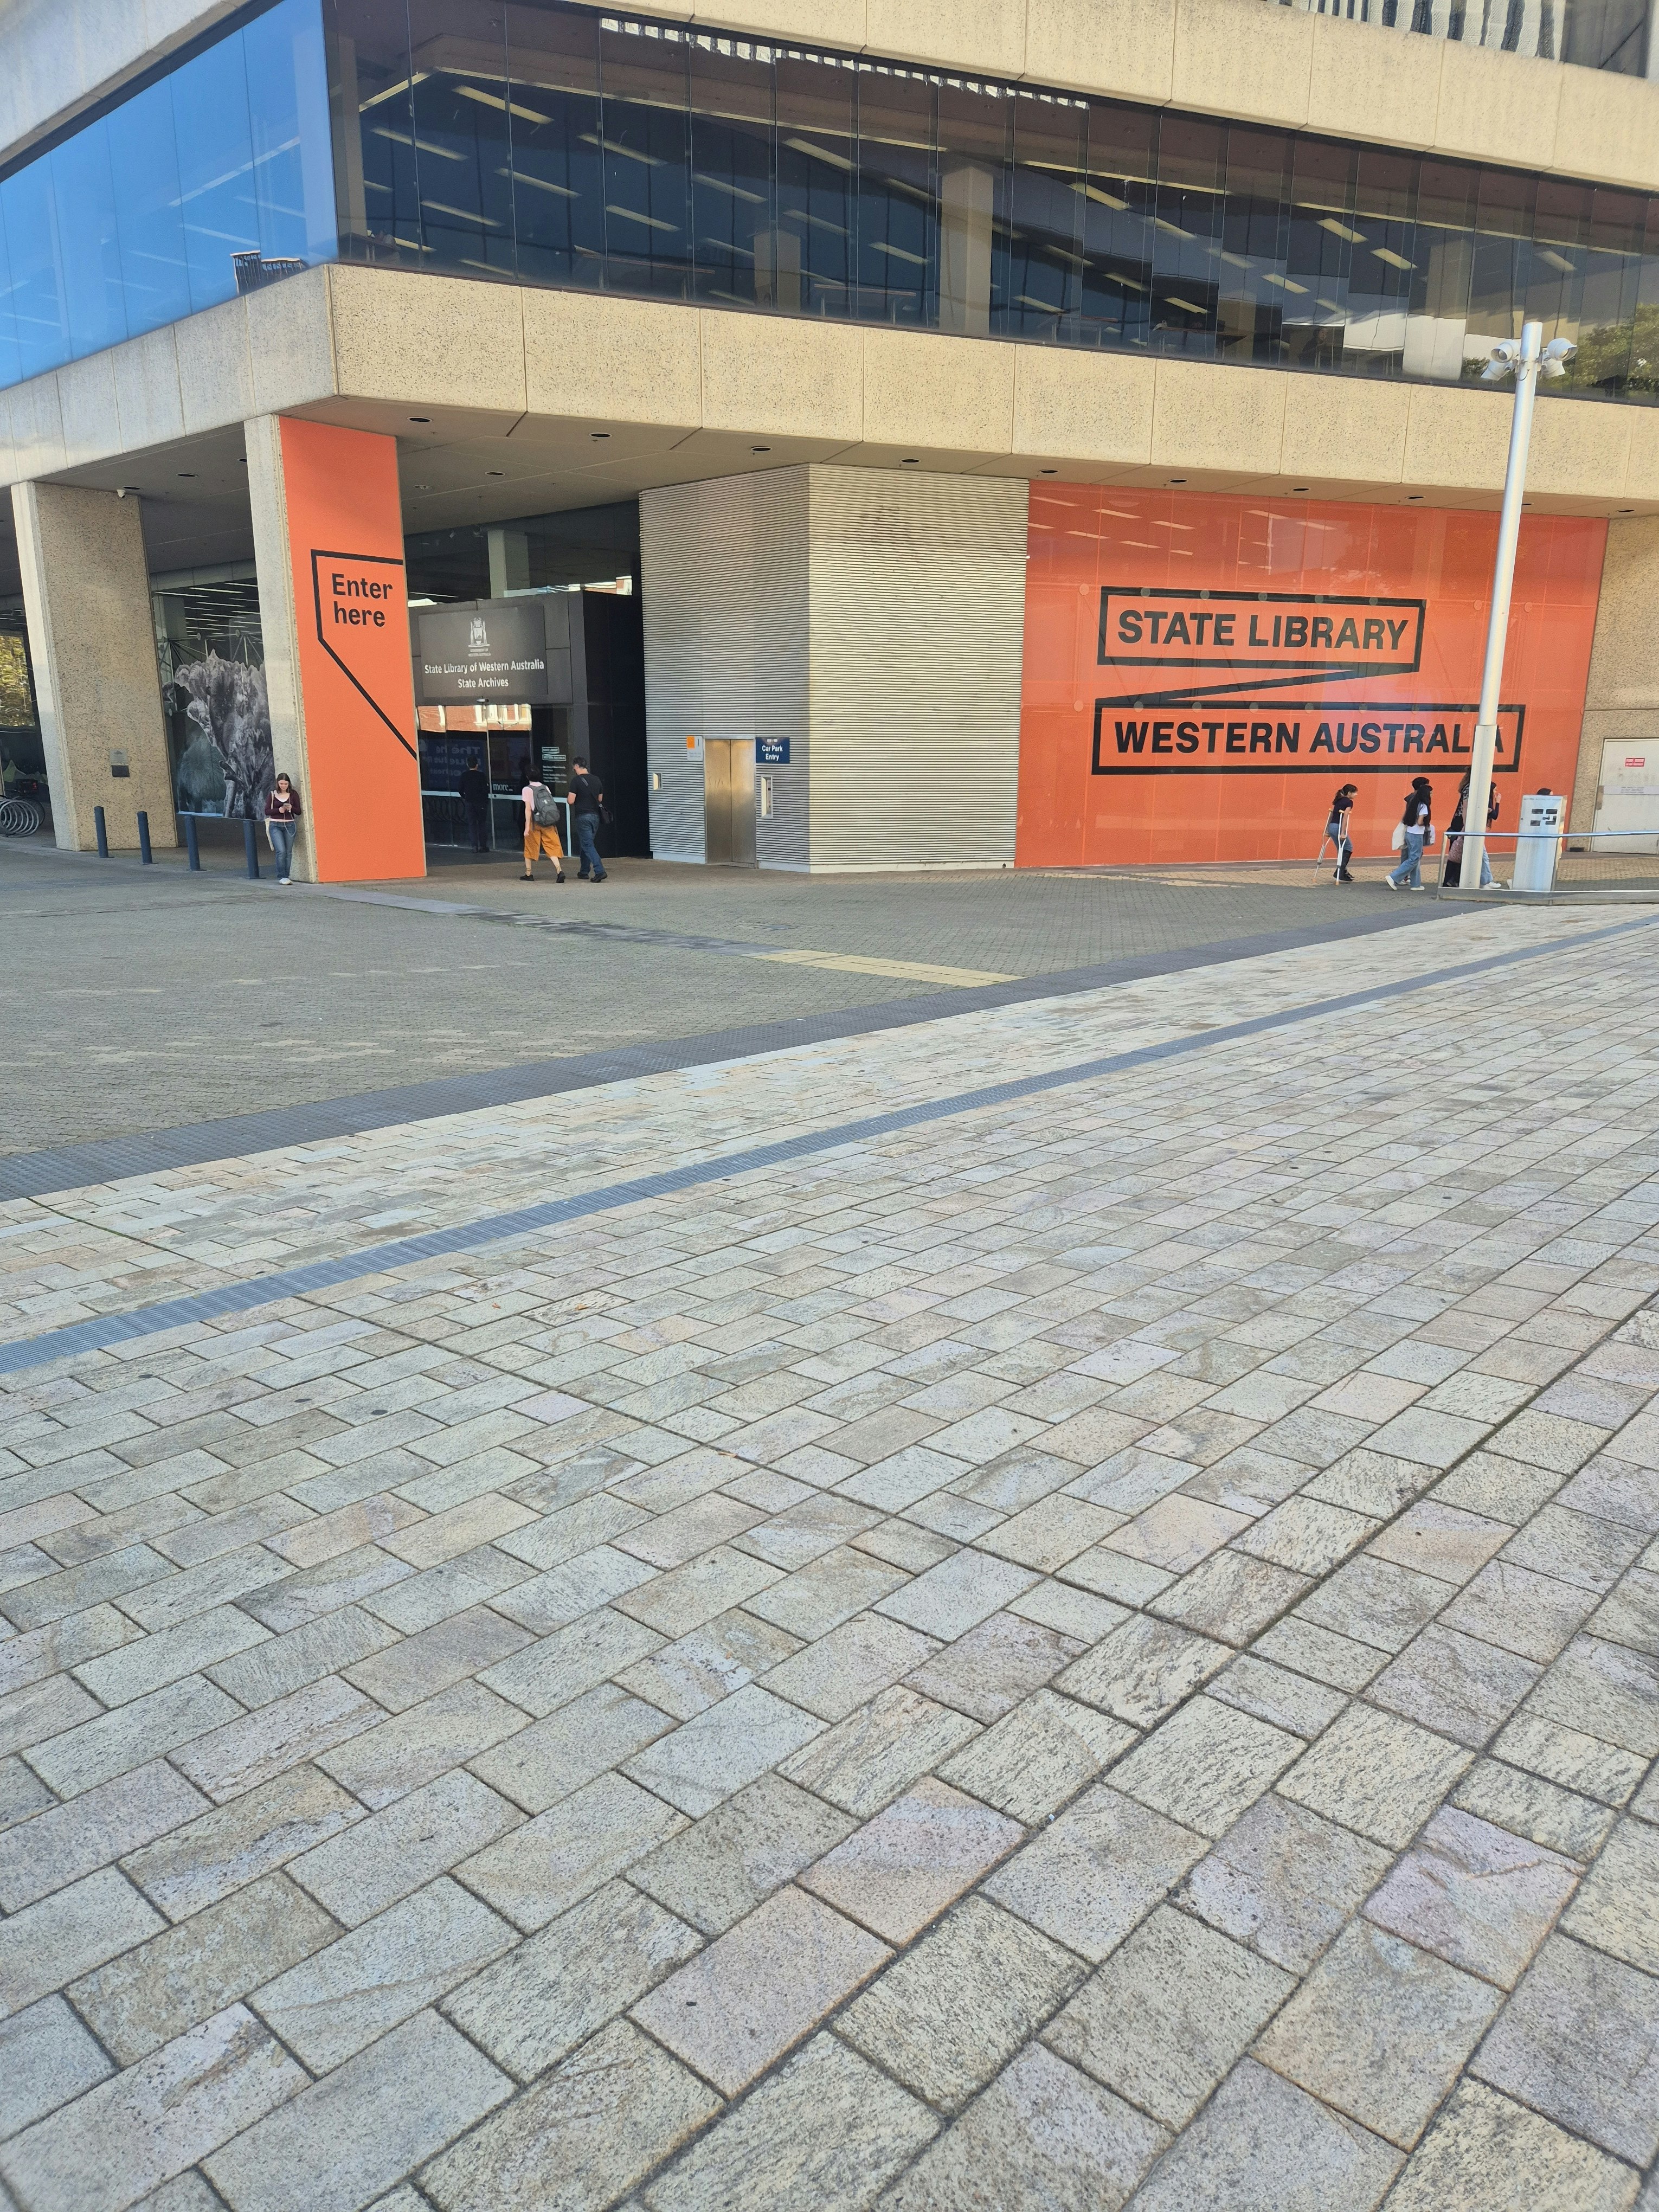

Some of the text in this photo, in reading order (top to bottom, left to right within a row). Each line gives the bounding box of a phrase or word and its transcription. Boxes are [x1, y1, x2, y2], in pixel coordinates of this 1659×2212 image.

[332, 573, 393, 599] Enter
[333, 601, 385, 627] here
[1118, 609, 1409, 650] STATE LIBRARY
[425, 659, 544, 674] State Library of Western Australia
[458, 677, 509, 689] State Archives
[1115, 722, 1504, 753] WESTERN AUSTRAL
[766, 753, 780, 761] Entry
